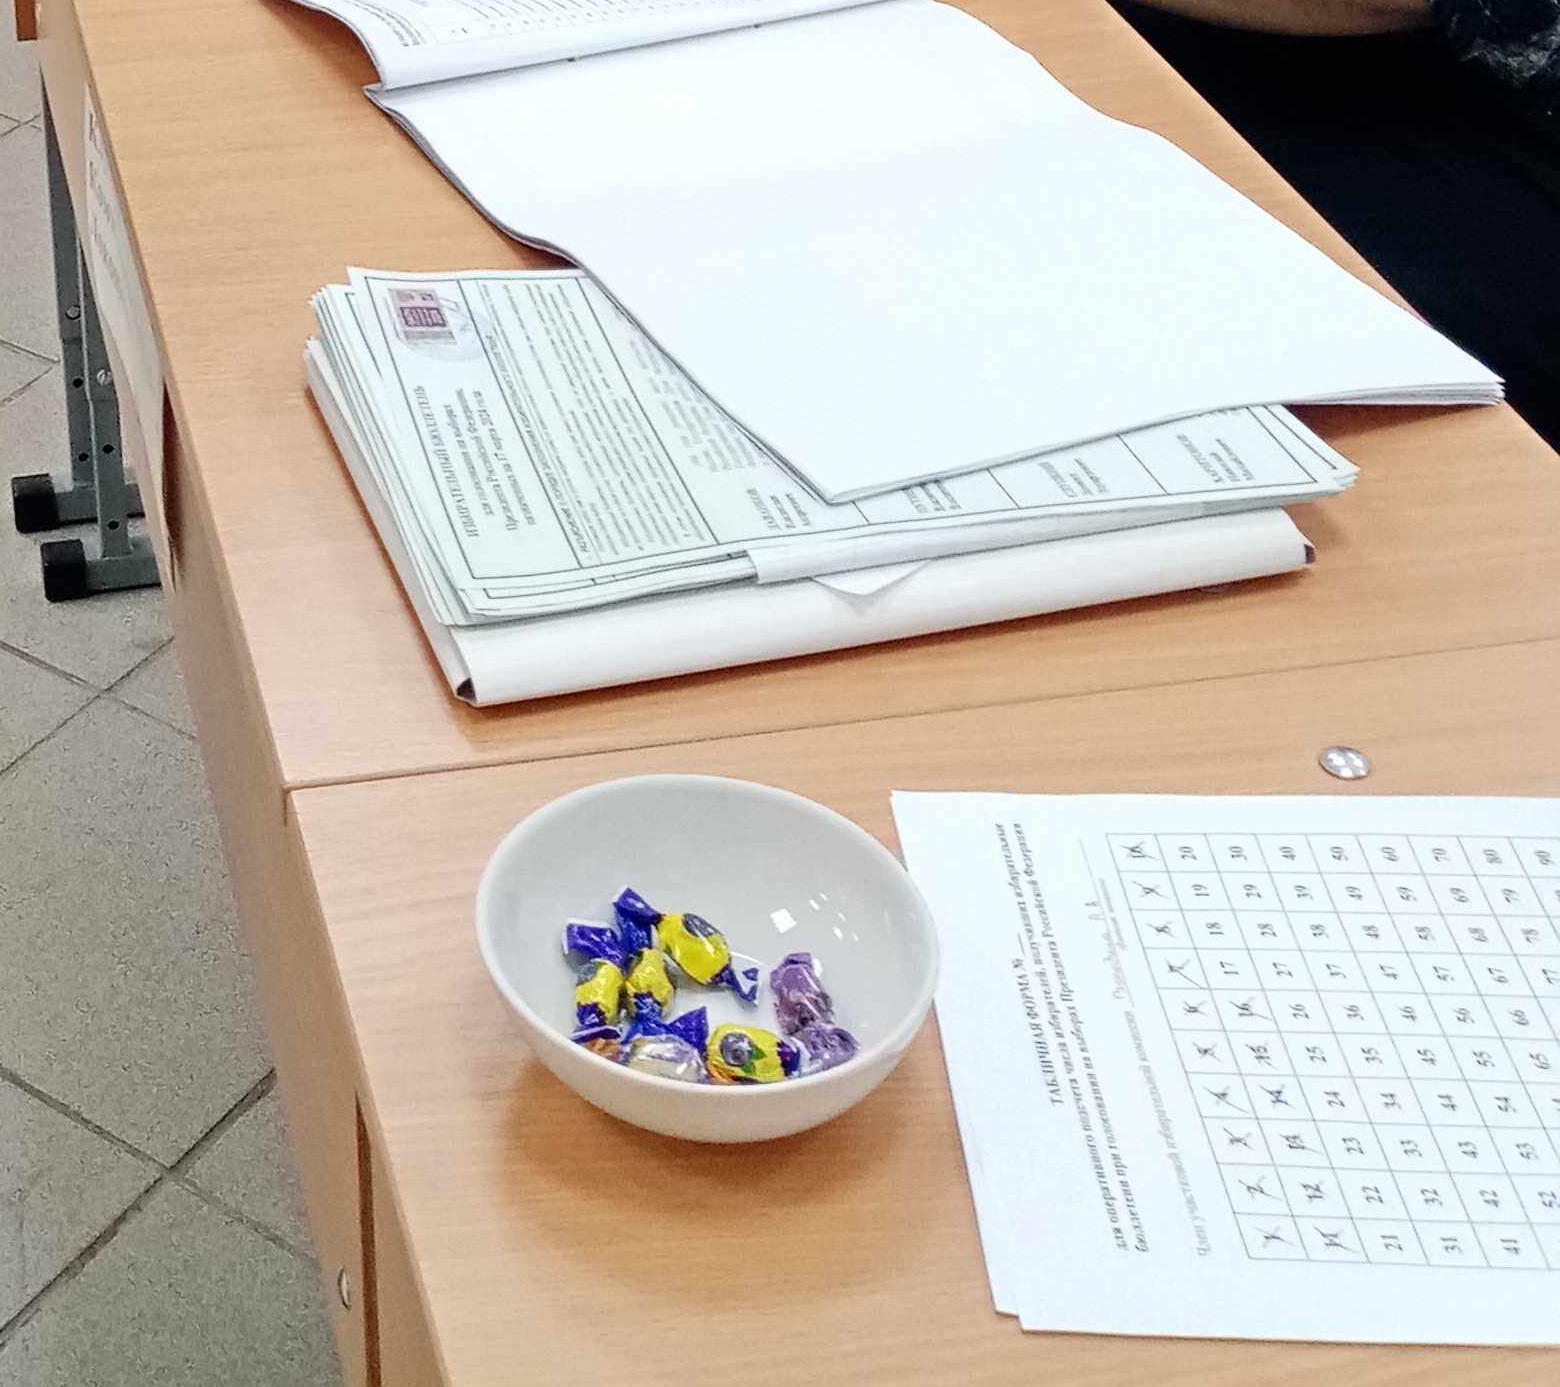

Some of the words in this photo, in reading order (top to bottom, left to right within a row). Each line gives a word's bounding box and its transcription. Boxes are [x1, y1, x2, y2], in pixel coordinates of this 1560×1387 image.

[1013, 822, 1037, 879] Федерации
[1177, 845, 1198, 861] 20
[1227, 845, 1248, 861] 30
[1278, 845, 1297, 862] 40
[1329, 845, 1350, 862] 50
[1379, 846, 1399, 863] 60
[1430, 847, 1448, 863] 70
[1482, 848, 1503, 865] 80
[1533, 849, 1554, 866] 90
[995, 822, 1025, 899] избирательные
[1190, 883, 1210, 897] 19
[1242, 883, 1263, 900] 29
[1293, 884, 1314, 900] 39
[1344, 885, 1364, 902] 49
[1396, 886, 1418, 902] 59
[1449, 887, 1470, 904] 69
[1501, 888, 1518, 904] 79
[1026, 878, 1055, 940] Российской
[1016, 899, 1044, 966] получивших
[1205, 921, 1225, 936] 18
[1256, 922, 1278, 938] 28
[1309, 923, 1330, 939] 38
[1361, 924, 1381, 940] 48
[1414, 925, 1436, 942] 58
[1467, 926, 1489, 943] 68
[1520, 927, 1540, 944] 78
[1046, 939, 1075, 1004] Президента
[1218, 960, 1240, 976] 17
[1271, 961, 1294, 978] 27
[1324, 962, 1348, 980] 37
[1378, 963, 1400, 981] 47
[1431, 965, 1456, 982] 57
[1486, 966, 1509, 984] 67
[1016, 972, 1040, 1021] ФОРМА
[1033, 967, 1065, 1039] избирателей,
[1288, 1003, 1311, 1020] 26
[1343, 1004, 1365, 1021] 36
[1398, 1005, 1418, 1023] 46
[1453, 1007, 1476, 1024] 56
[1508, 1009, 1530, 1027] 66
[1066, 1004, 1089, 1056] выборах
[1124, 1010, 1150, 1063] комиссии
[1028, 1020, 1065, 1106] ТАБЛИЧНАЯ
[1059, 1038, 1075, 1076] числа
[1080, 1055, 1095, 1071] на
[1304, 1045, 1328, 1064] 25
[1360, 1046, 1384, 1065] 35
[1415, 1048, 1438, 1067] 45
[1471, 1050, 1496, 1068] 55
[1527, 1052, 1552, 1071] 65
[1068, 1077, 1094, 1133] подсчета
[1137, 1063, 1179, 1150] избирательной
[1322, 1090, 1346, 1108] 24
[1379, 1092, 1402, 1110] 34
[1436, 1093, 1458, 1113] 44
[1493, 1095, 1518, 1114] 54
[1084, 1071, 1121, 1150] голосовании
[1341, 1136, 1365, 1156] 23
[1398, 1139, 1423, 1158] 33
[1456, 1141, 1480, 1160] 43
[1515, 1142, 1539, 1161] 53
[1110, 1152, 1132, 1178] при
[1083, 1134, 1121, 1224] оперативного
[1165, 1151, 1207, 1222] участковой
[1360, 1185, 1385, 1205] 22
[1419, 1188, 1444, 1207] 32
[1478, 1189, 1501, 1209] 42
[1117, 1178, 1151, 1254] бюллетени
[1110, 1226, 1131, 1252] для
[1190, 1223, 1213, 1258] Член
[1379, 1234, 1404, 1252] 21
[1439, 1236, 1463, 1254] 31
[1499, 1238, 1521, 1256] 41
